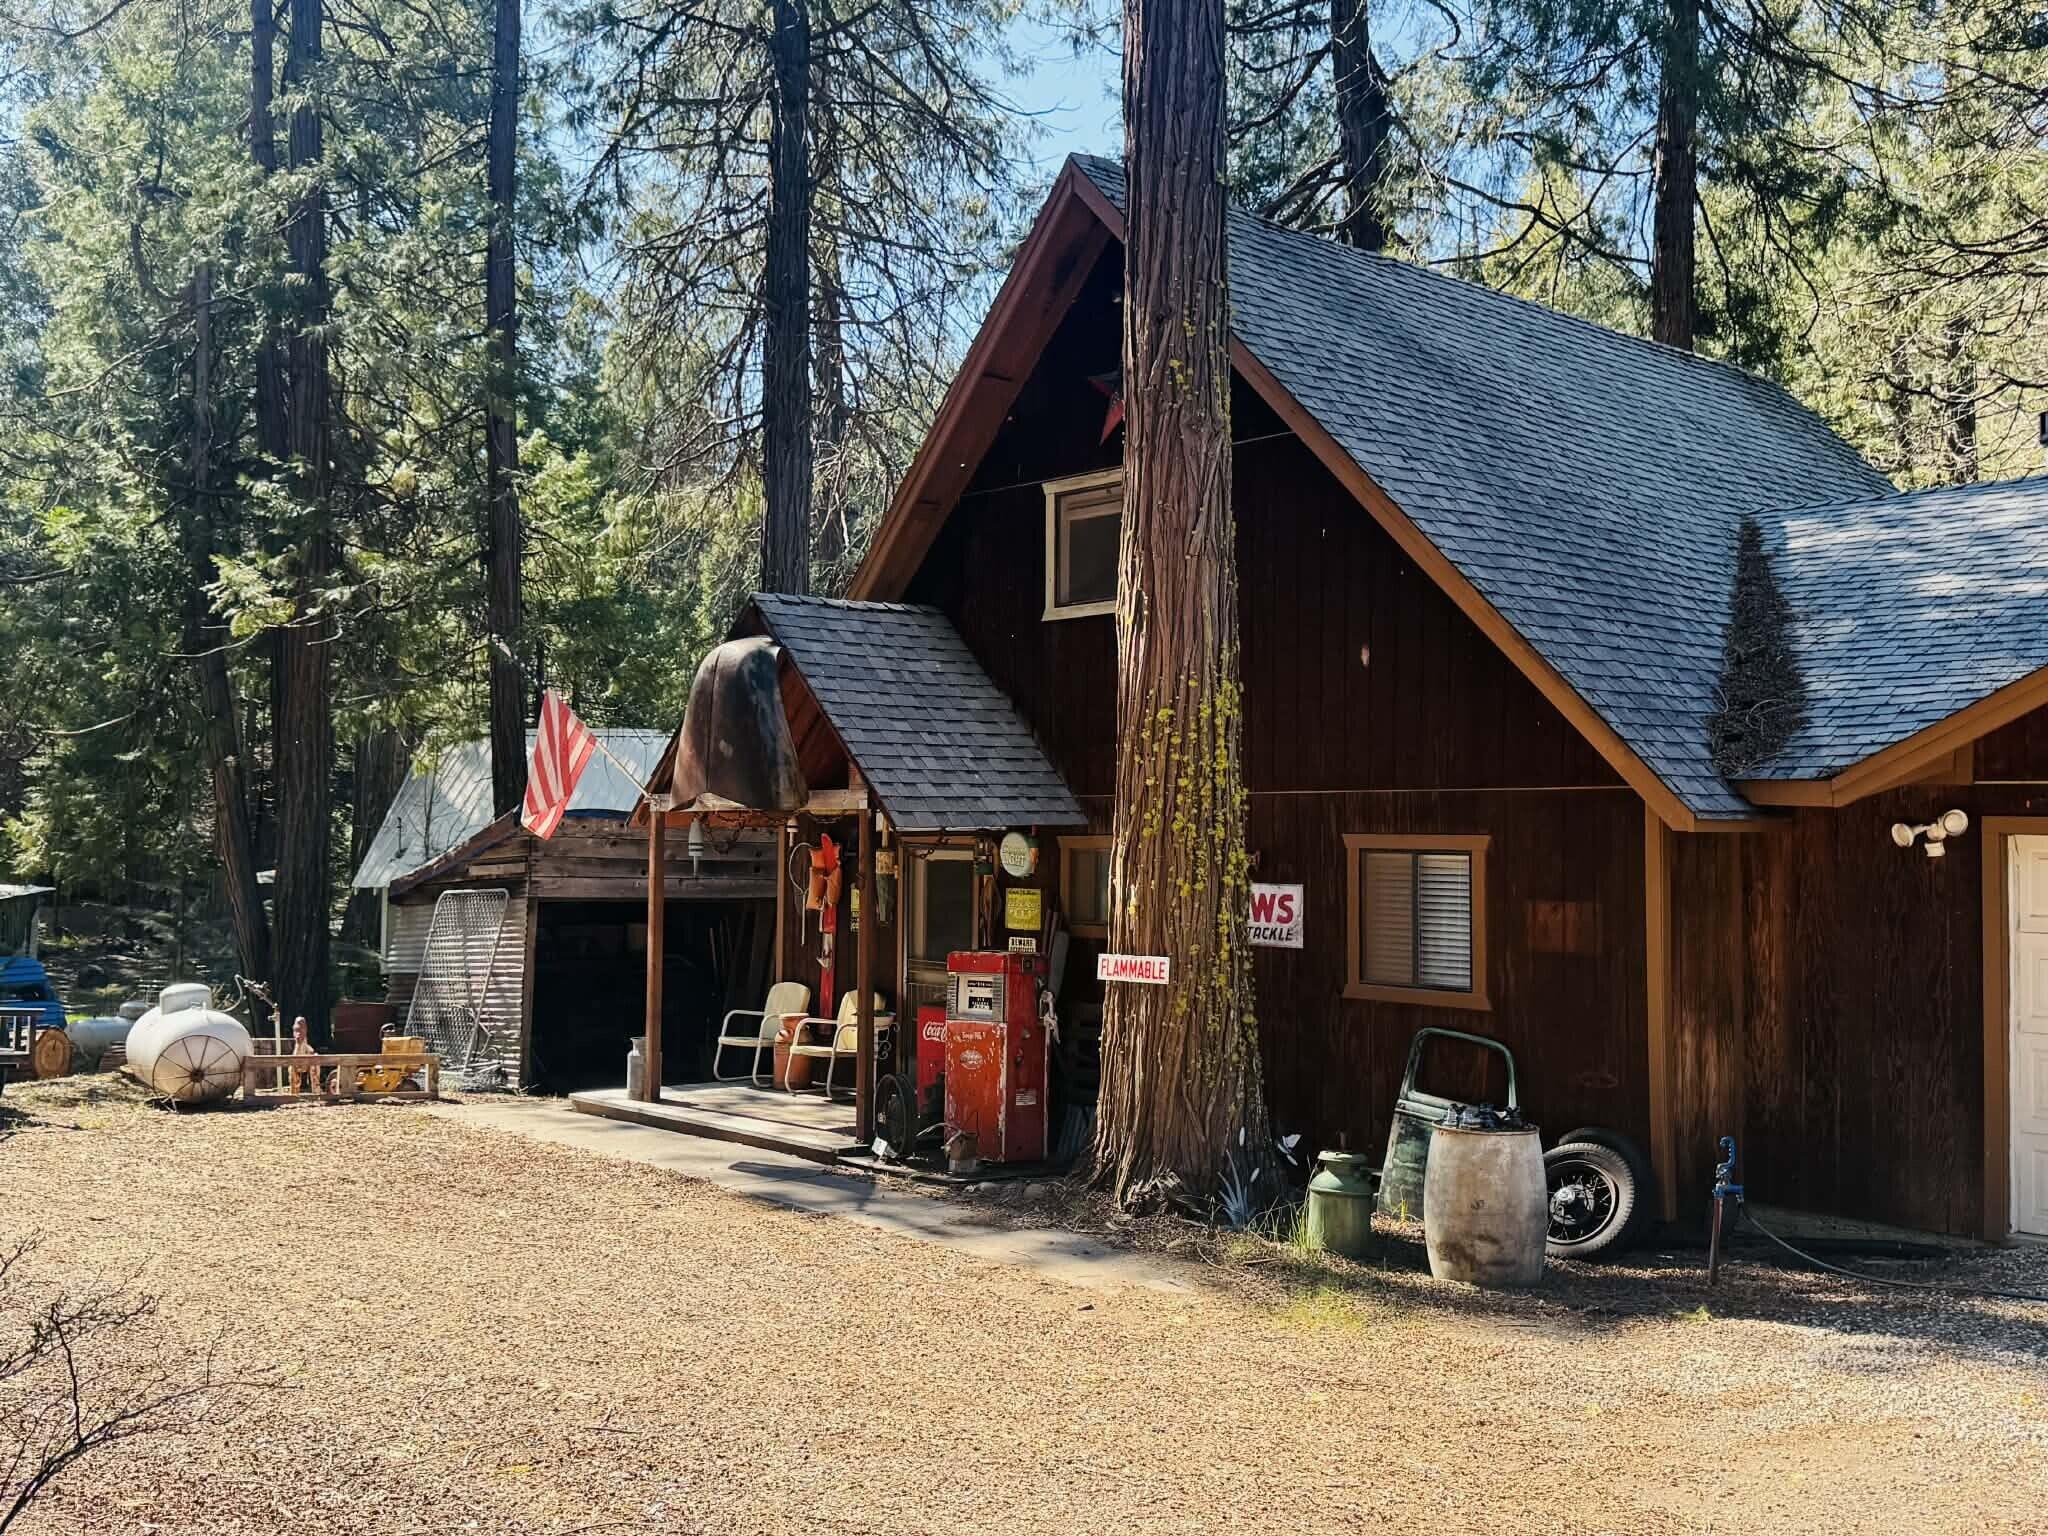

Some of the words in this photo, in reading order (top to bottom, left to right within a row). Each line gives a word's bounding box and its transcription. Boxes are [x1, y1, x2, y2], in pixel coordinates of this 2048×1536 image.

[1250, 893, 1294, 924] WS
[1248, 926, 1294, 941] TACKLE
[1101, 958, 1166, 980] FLAMMABLE
